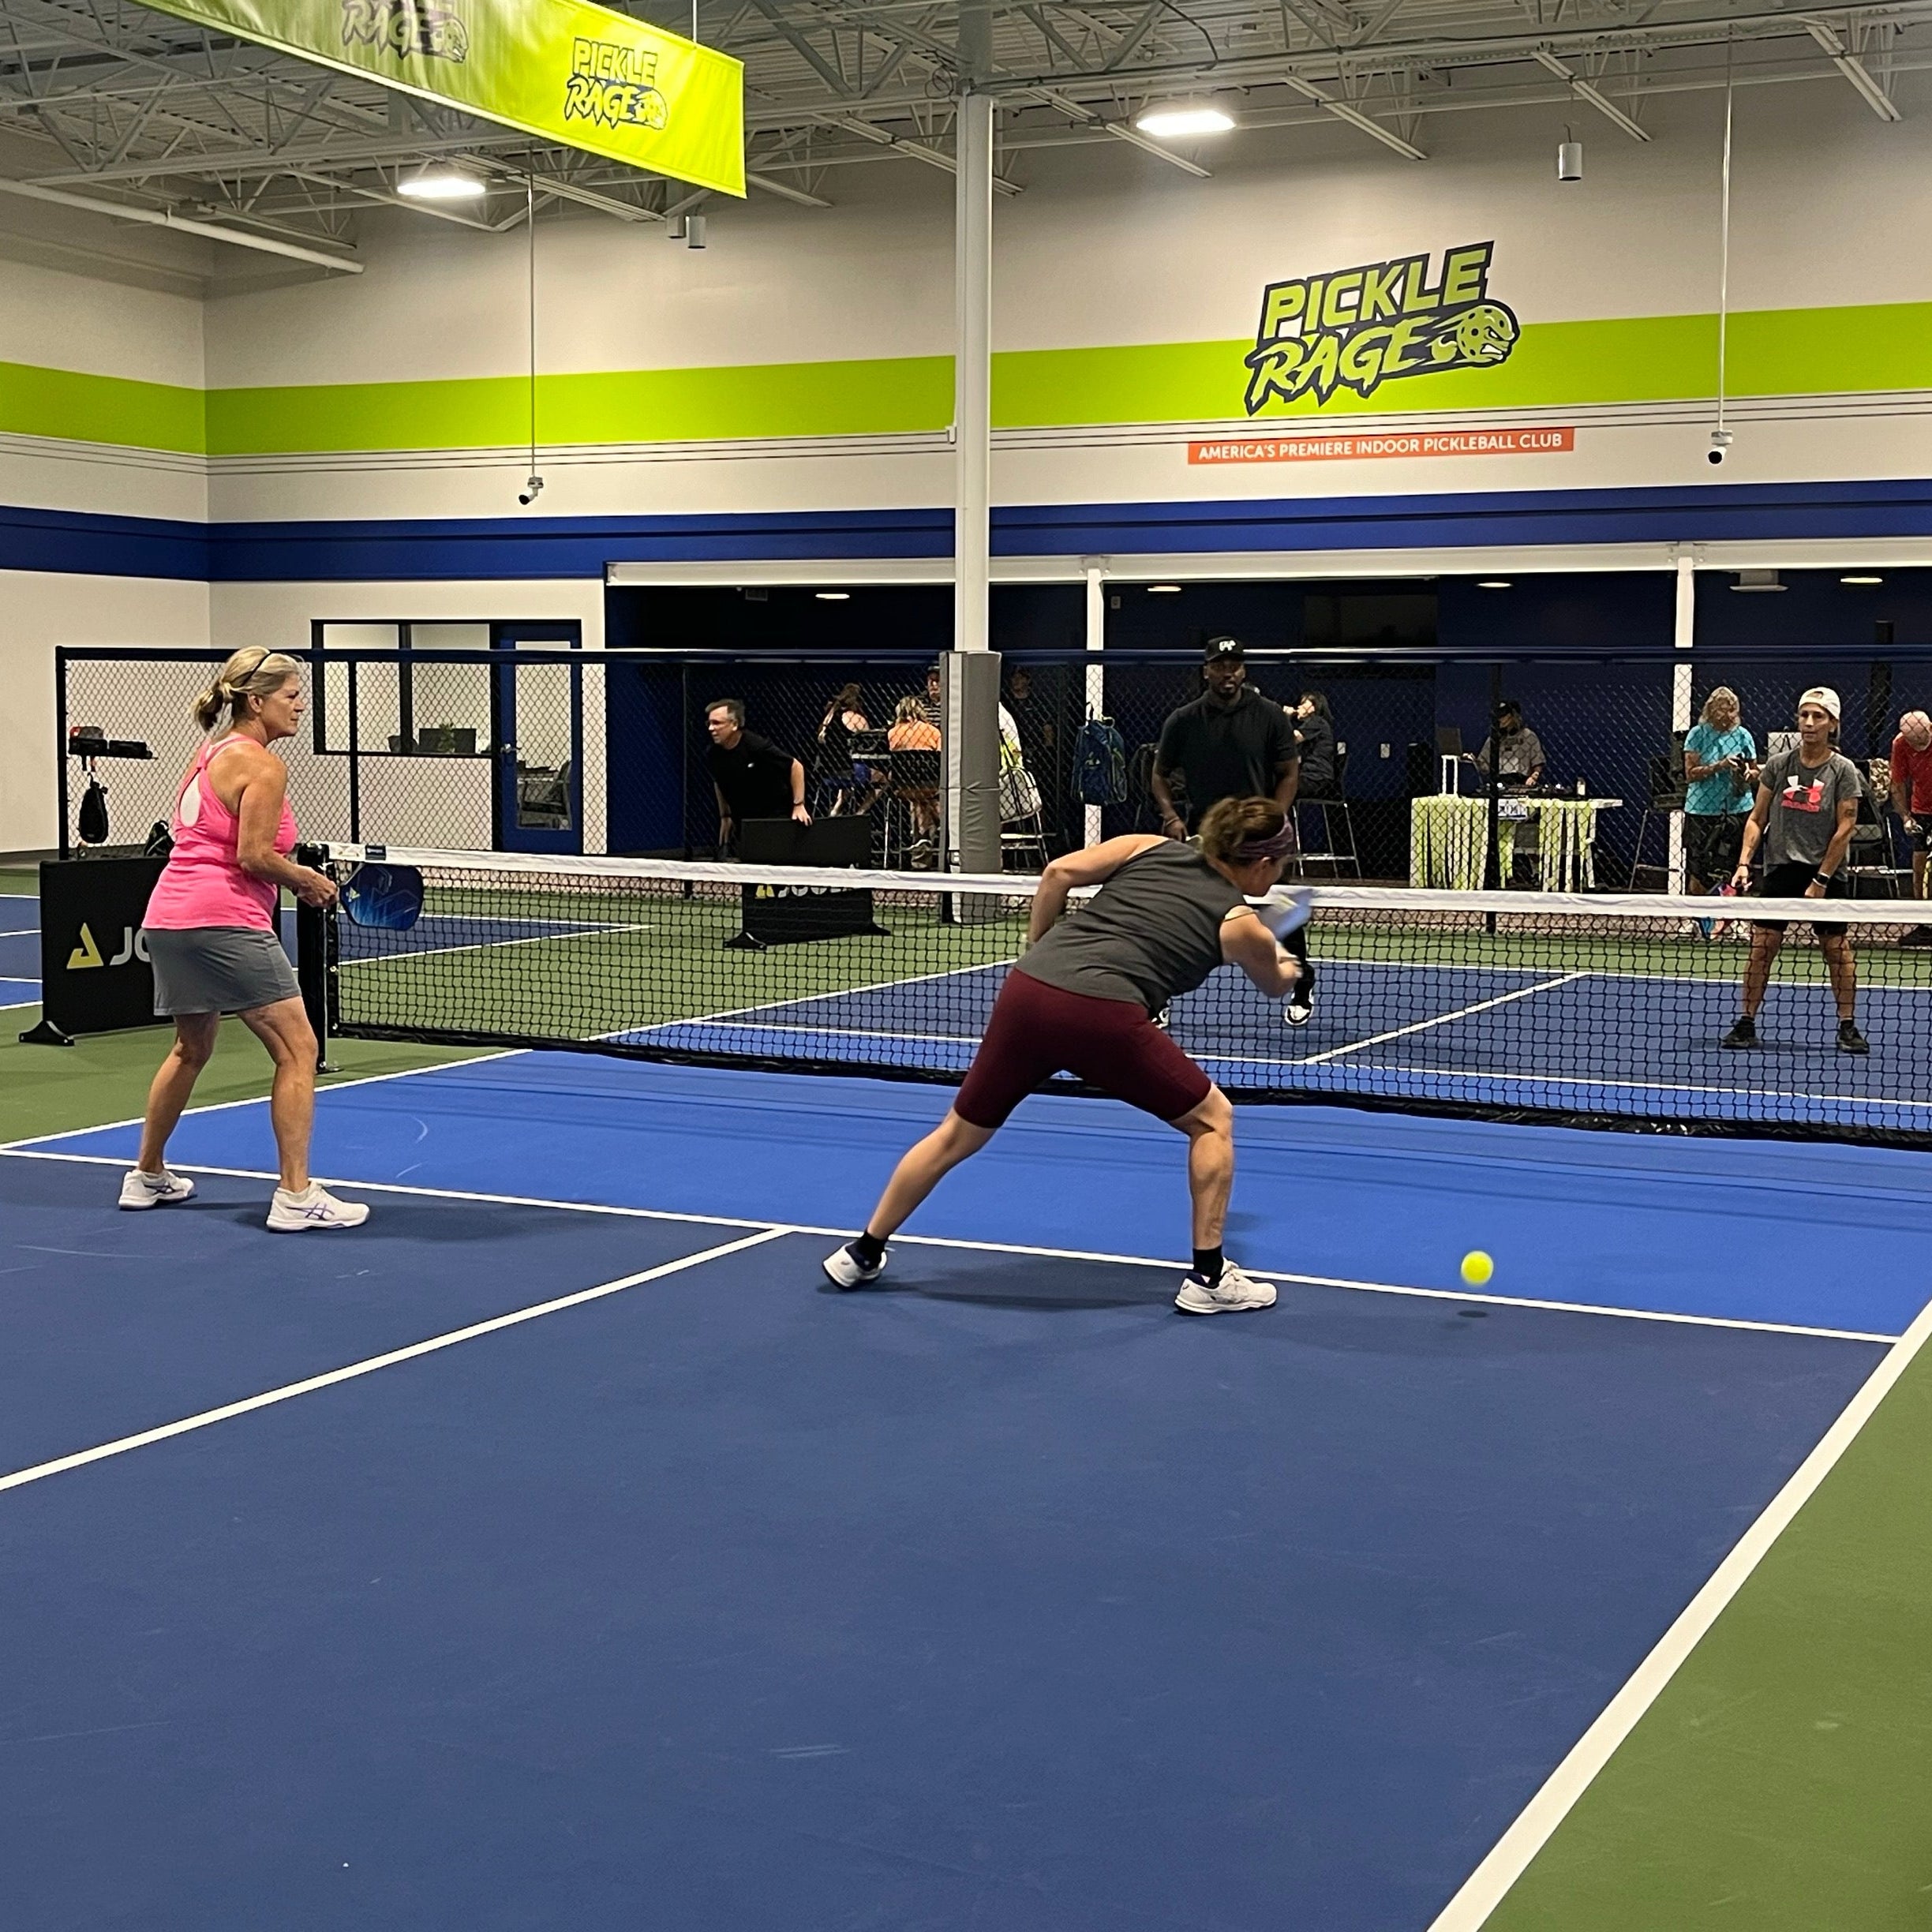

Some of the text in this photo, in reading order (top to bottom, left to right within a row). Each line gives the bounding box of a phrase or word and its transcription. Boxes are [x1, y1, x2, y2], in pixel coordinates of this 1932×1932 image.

[572, 37, 658, 88] PICKLE
[564, 76, 640, 129] RAGE
[1260, 243, 1491, 340] PICKLE
[1245, 316, 1433, 414] RAGE
[1198, 433, 1562, 460] AMERICA'S PREMIERE INDOOR PICKLEBALL CLUB
